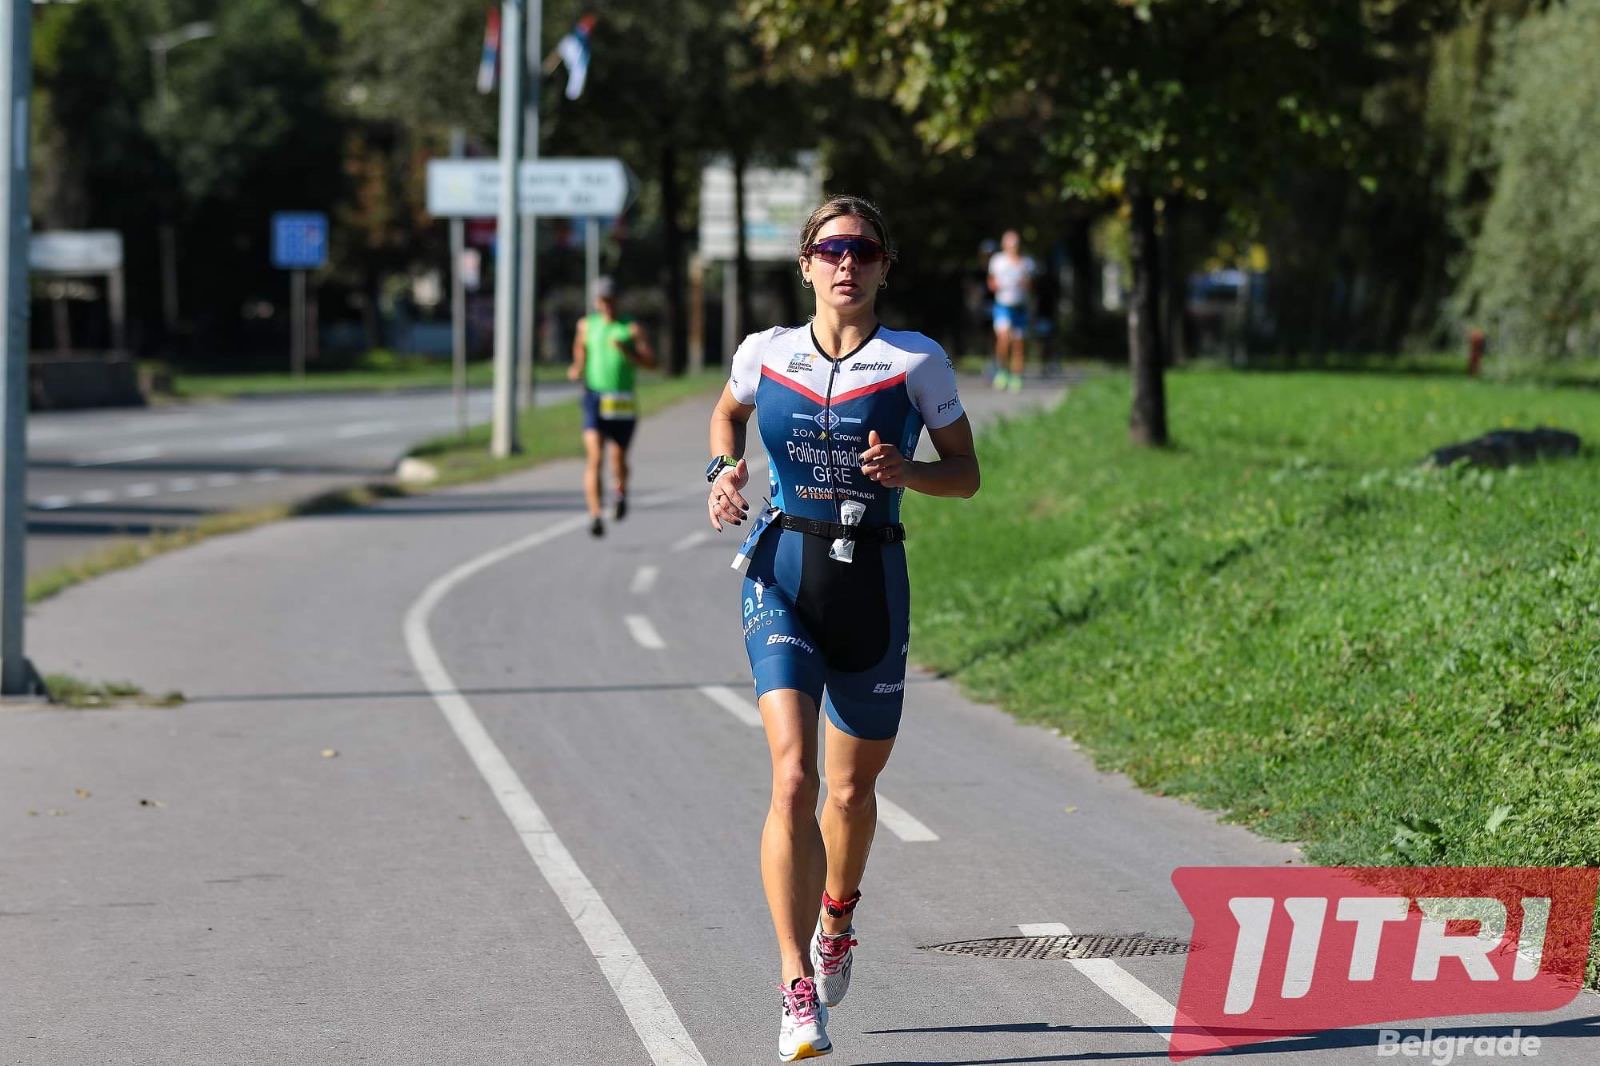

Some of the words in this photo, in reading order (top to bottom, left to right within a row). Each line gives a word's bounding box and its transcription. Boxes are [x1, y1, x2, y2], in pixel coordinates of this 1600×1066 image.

[850, 361, 893, 371] Santini
[833, 432, 861, 442] Crowe
[813, 466, 852, 484] GRE
[767, 633, 814, 654] Santini
